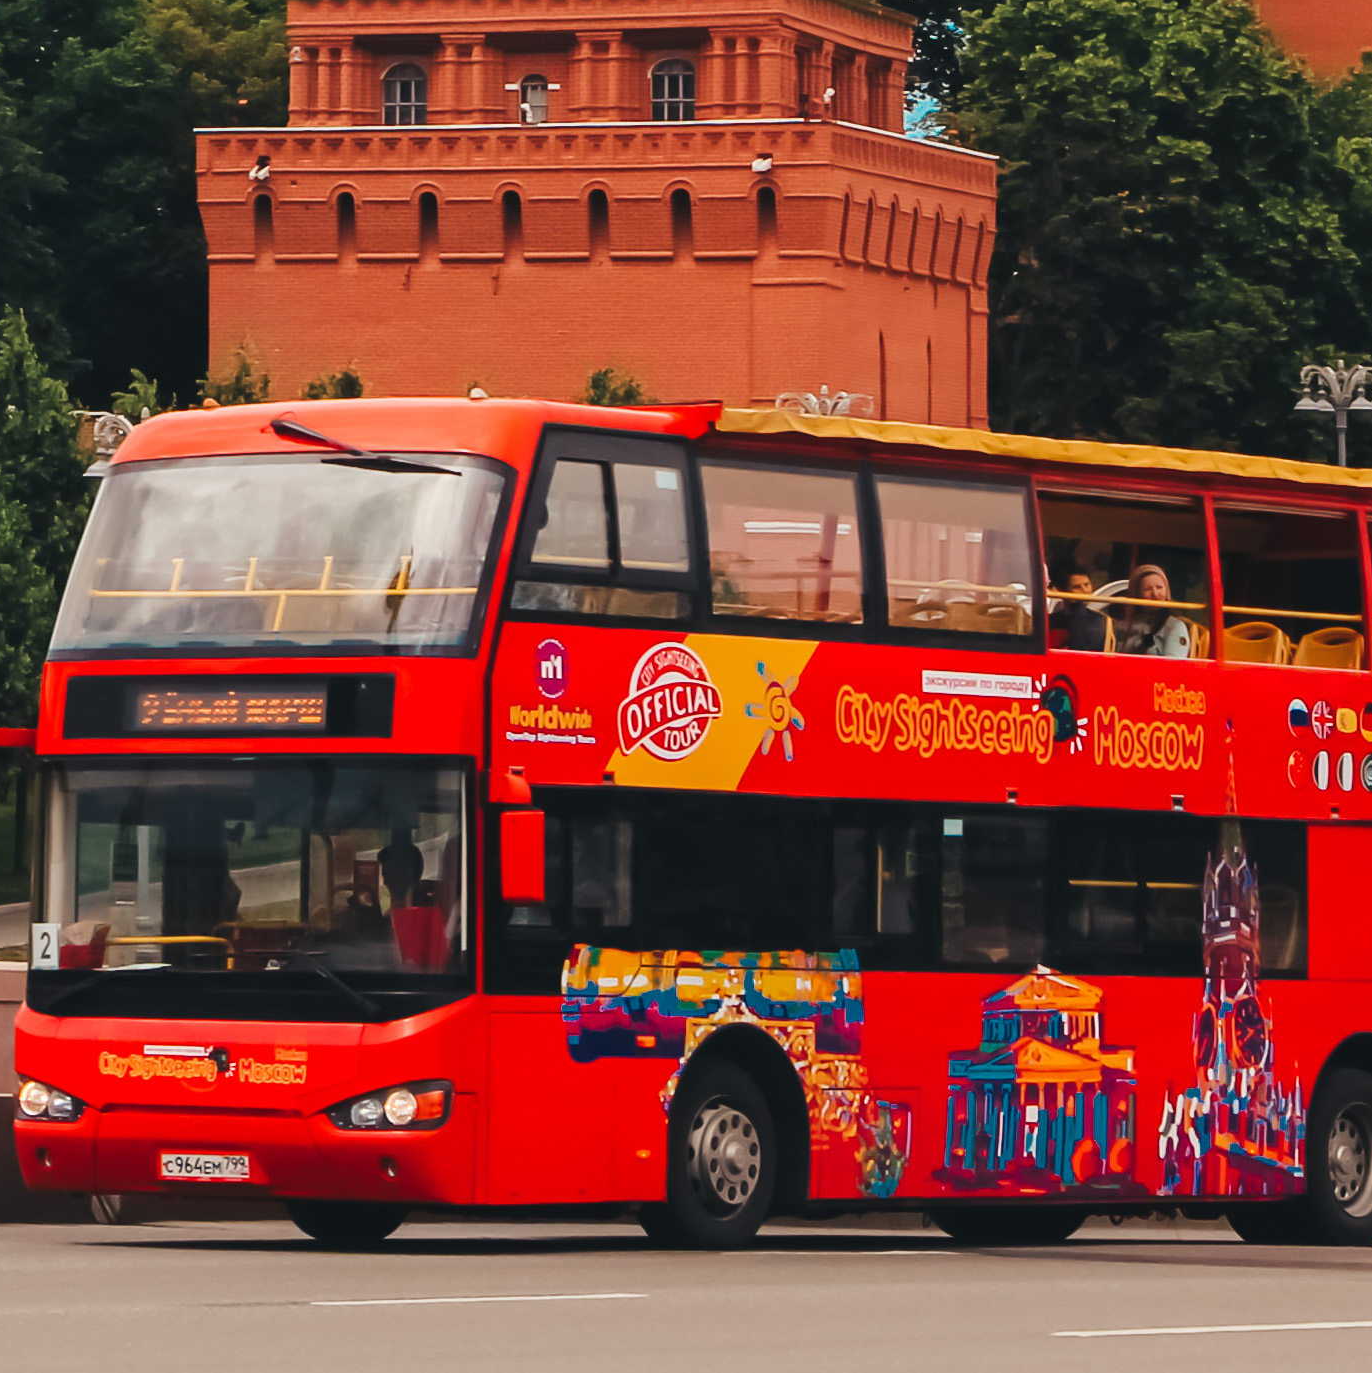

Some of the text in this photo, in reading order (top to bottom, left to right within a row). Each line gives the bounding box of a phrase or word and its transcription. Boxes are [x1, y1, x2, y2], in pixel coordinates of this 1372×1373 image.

[980, 679, 992, 689] по
[994, 680, 1029, 694] городу
[627, 686, 719, 739] OFFICIAL
[664, 720, 702, 750] TOUR
[893, 692, 1056, 765] Sightseeing
[40, 931, 52, 960] 2
